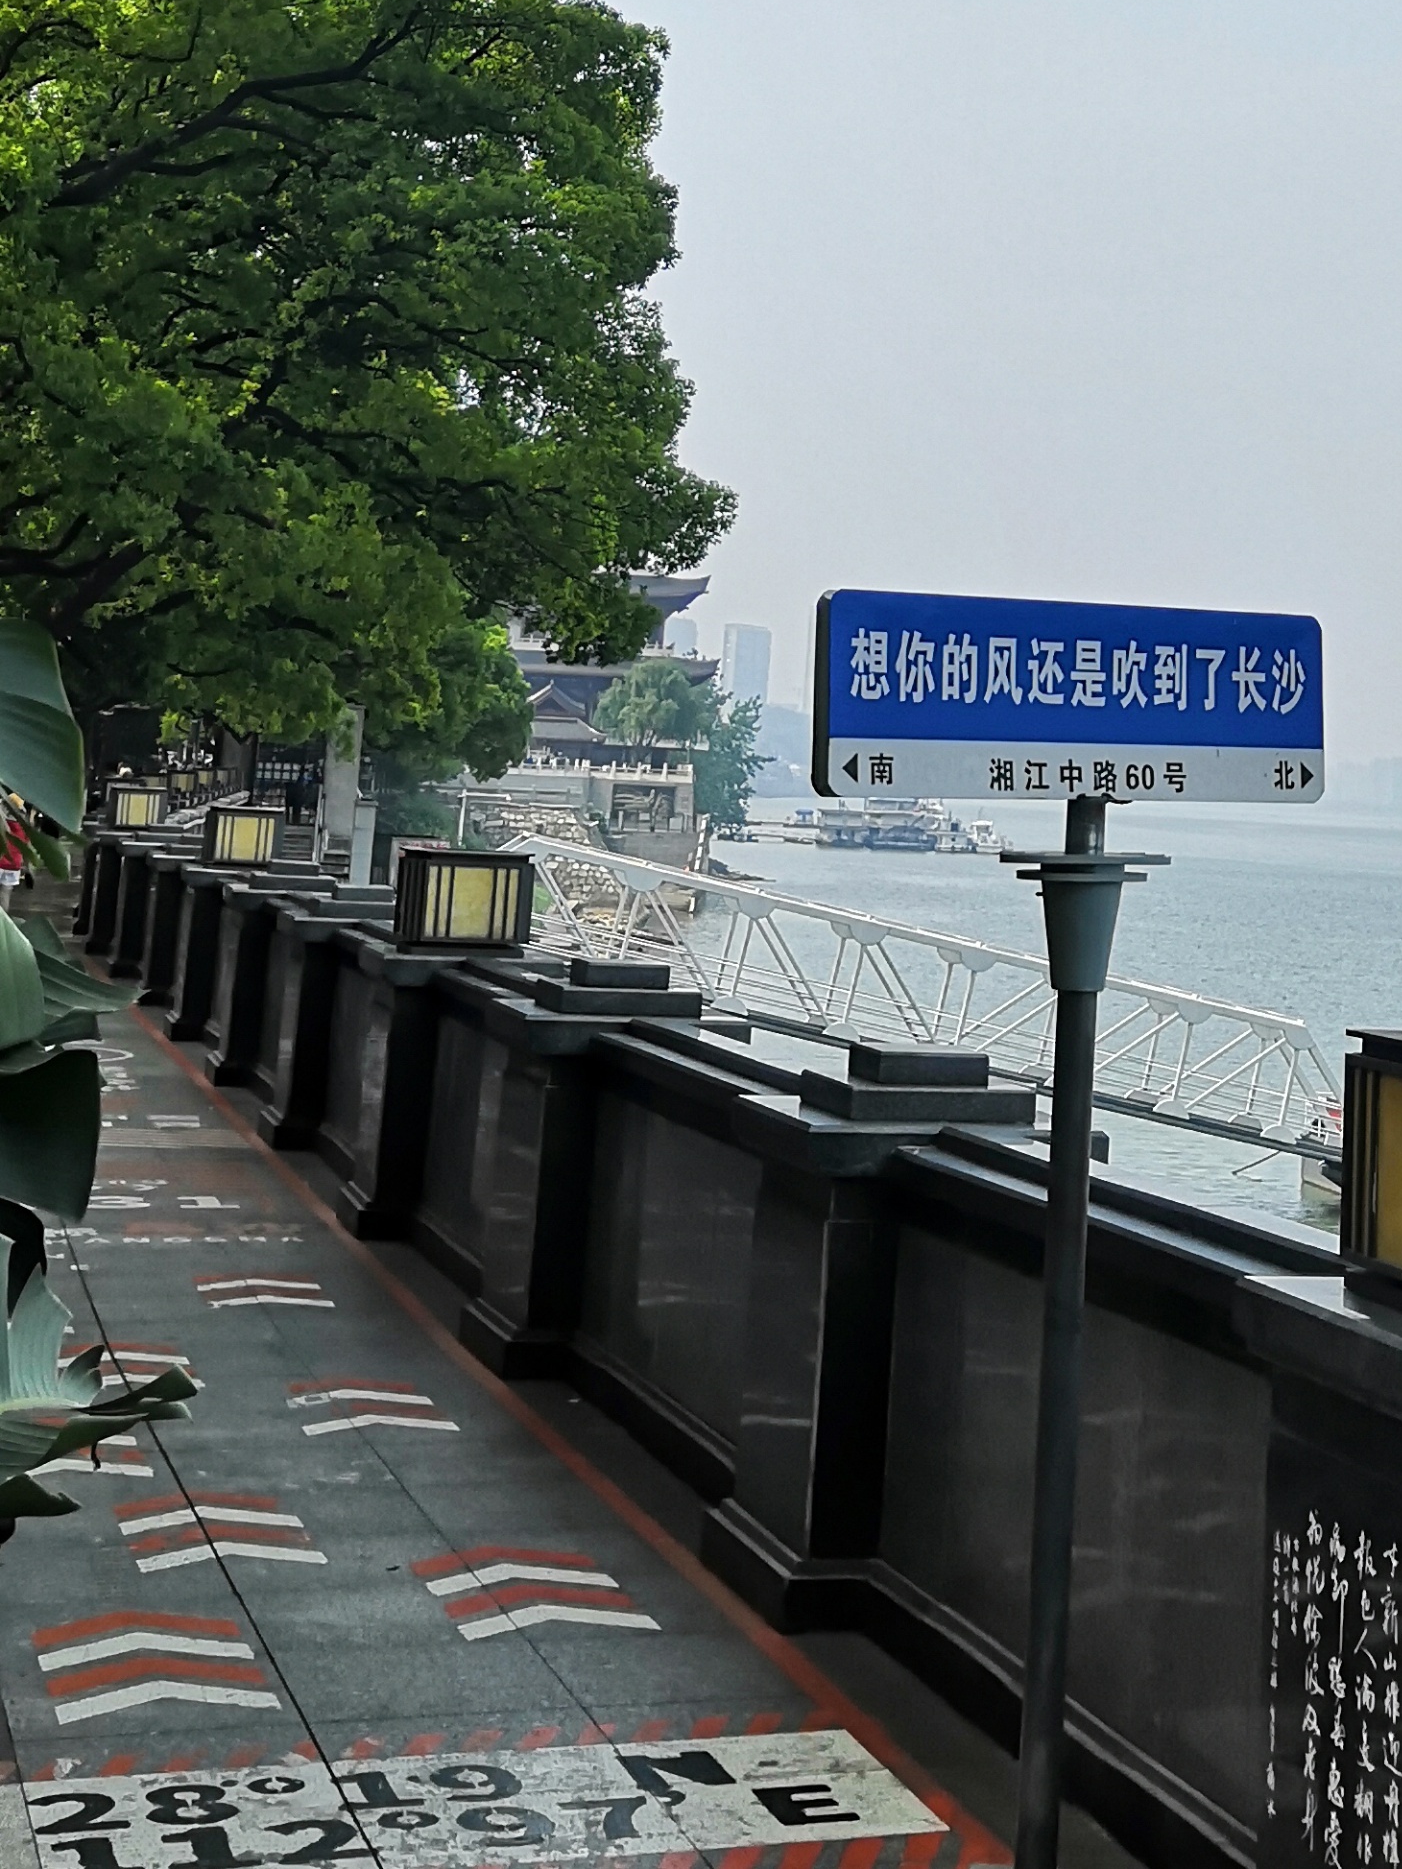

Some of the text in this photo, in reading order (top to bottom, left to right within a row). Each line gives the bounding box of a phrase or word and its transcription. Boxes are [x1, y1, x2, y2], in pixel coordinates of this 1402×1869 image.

[849, 628, 1307, 715] 想你的风还是吹到了长沙
[869, 753, 1296, 793] 南 湘江中路60号 北
[614, 1750, 738, 1797] N
[752, 1783, 861, 1827] E
